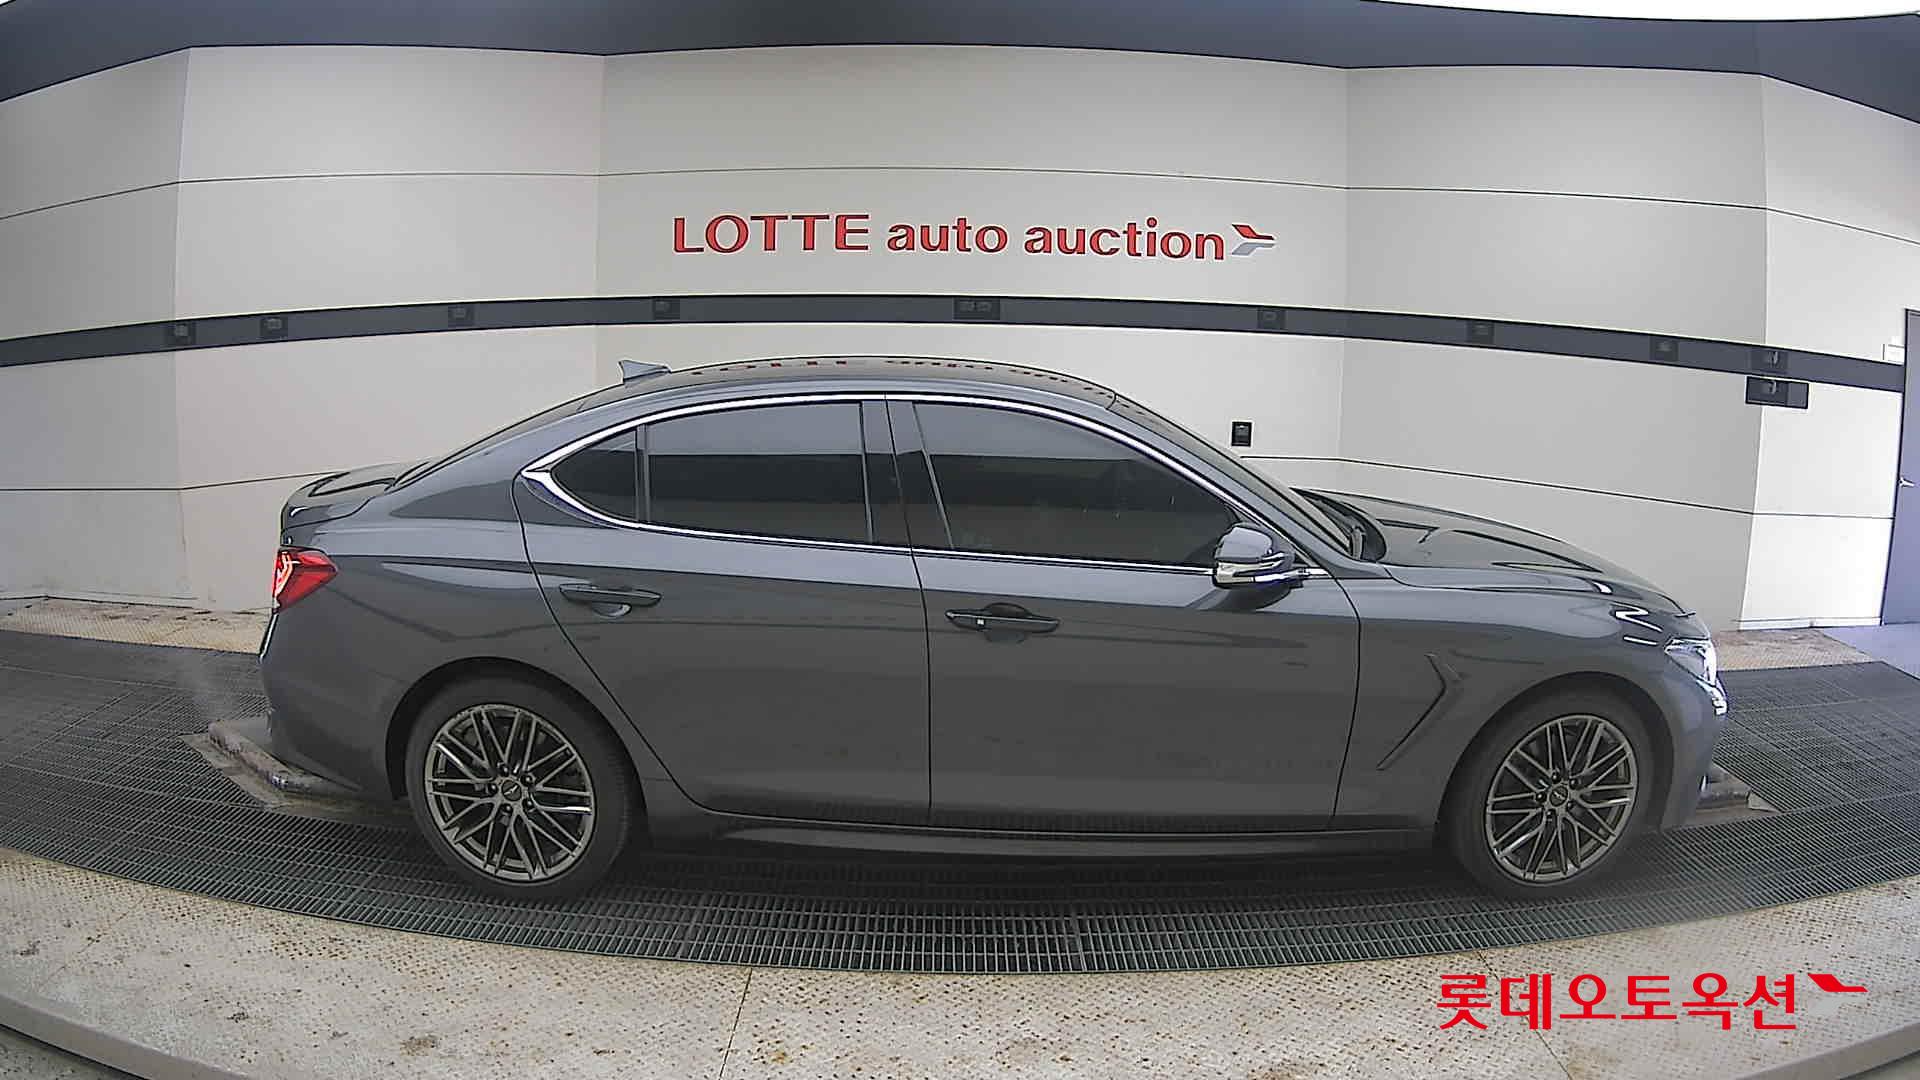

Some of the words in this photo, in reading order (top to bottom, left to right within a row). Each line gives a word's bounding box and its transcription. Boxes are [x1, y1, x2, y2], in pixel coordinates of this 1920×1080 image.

[673, 214, 869, 253] LOTTE
[887, 217, 1008, 253] auto
[1024, 218, 1225, 260] auction
